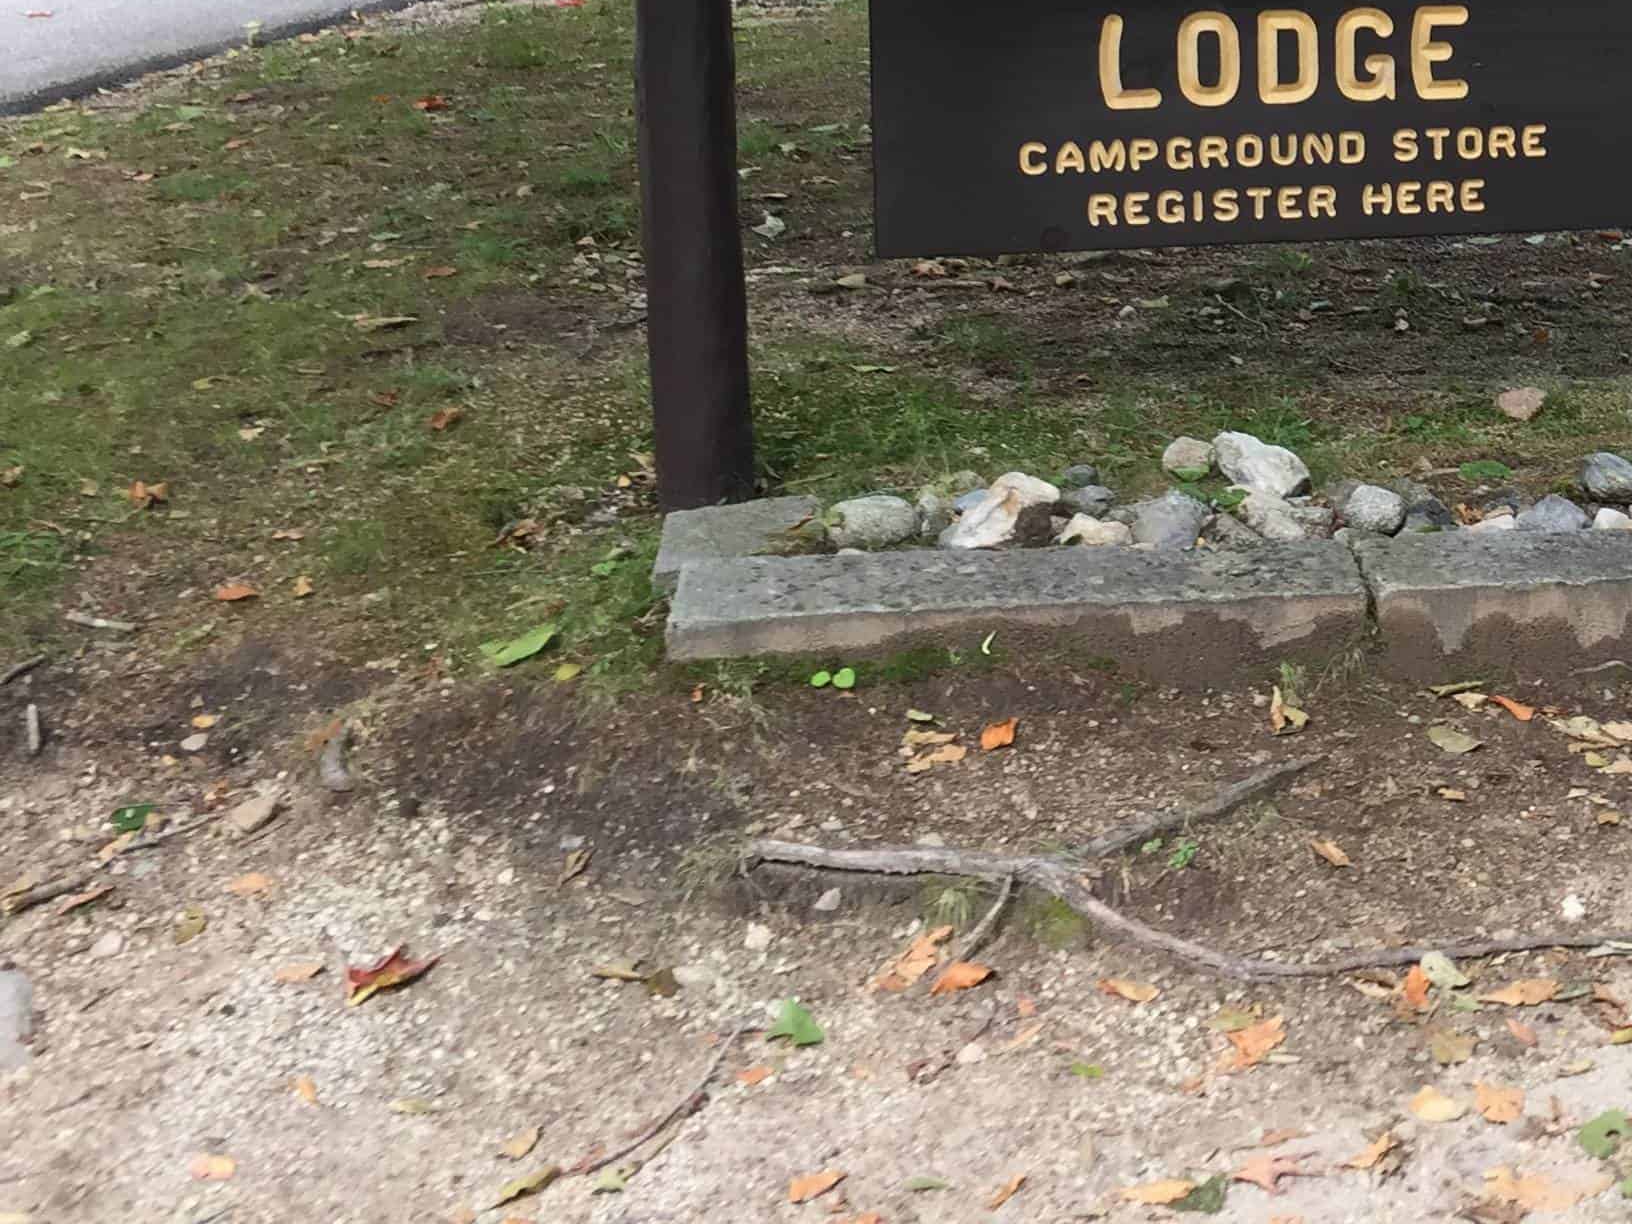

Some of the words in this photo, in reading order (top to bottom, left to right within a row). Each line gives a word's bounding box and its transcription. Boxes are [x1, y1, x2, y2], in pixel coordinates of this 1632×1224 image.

[1098, 5, 1470, 111] LODGE
[1019, 132, 1367, 176] CAMPGROUND
[1392, 124, 1548, 163] STORE
[1087, 186, 1337, 226] REGISTER
[1362, 179, 1486, 217] HERE
